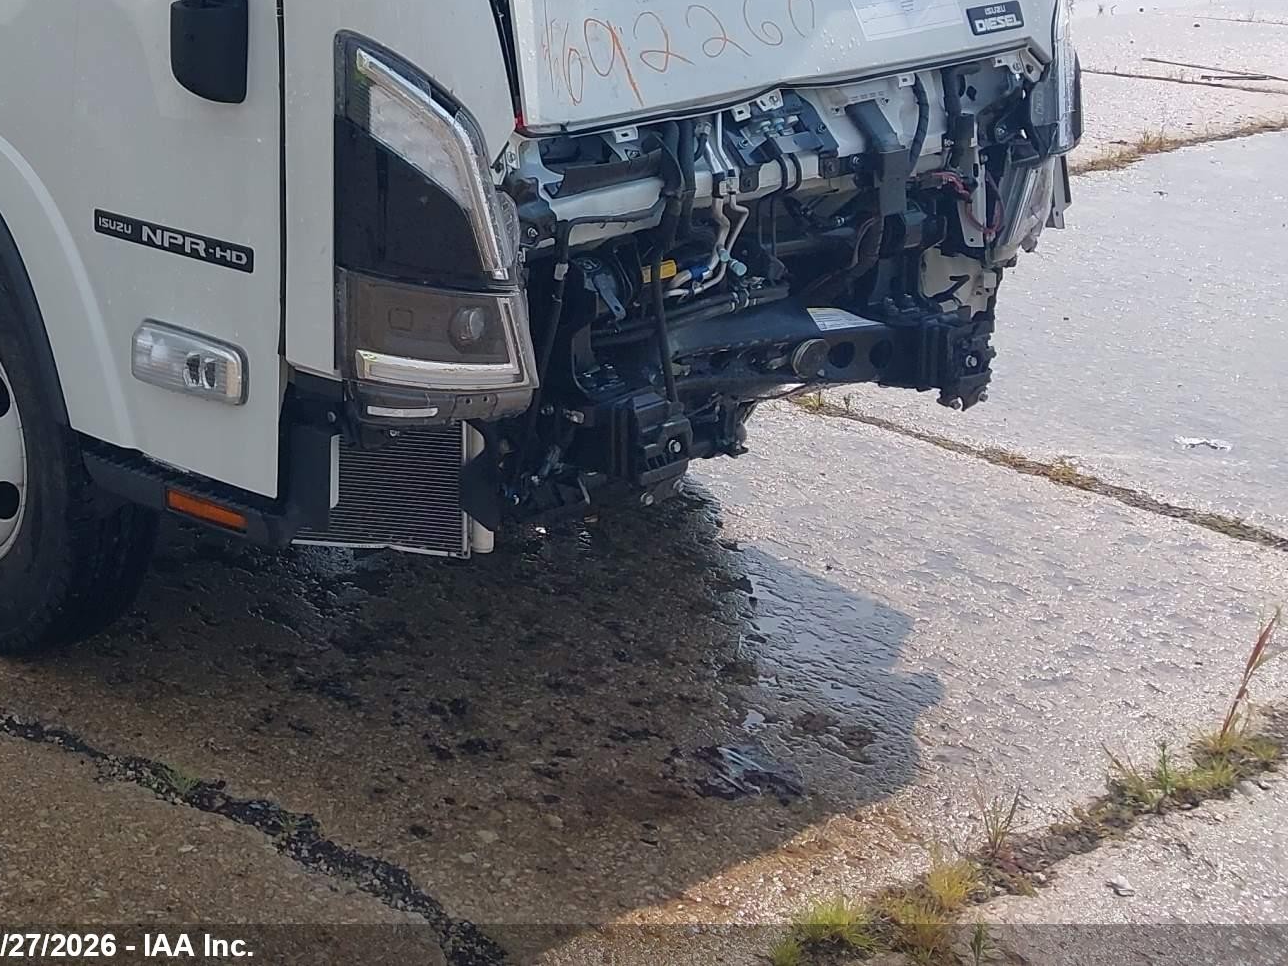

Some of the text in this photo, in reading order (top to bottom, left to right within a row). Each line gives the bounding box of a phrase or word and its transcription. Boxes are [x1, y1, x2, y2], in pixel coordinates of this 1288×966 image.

[984, 5, 1006, 16] ISUZU
[974, 14, 1022, 33] DIESEL
[98, 216, 248, 265] ISUZU NPR-HD
